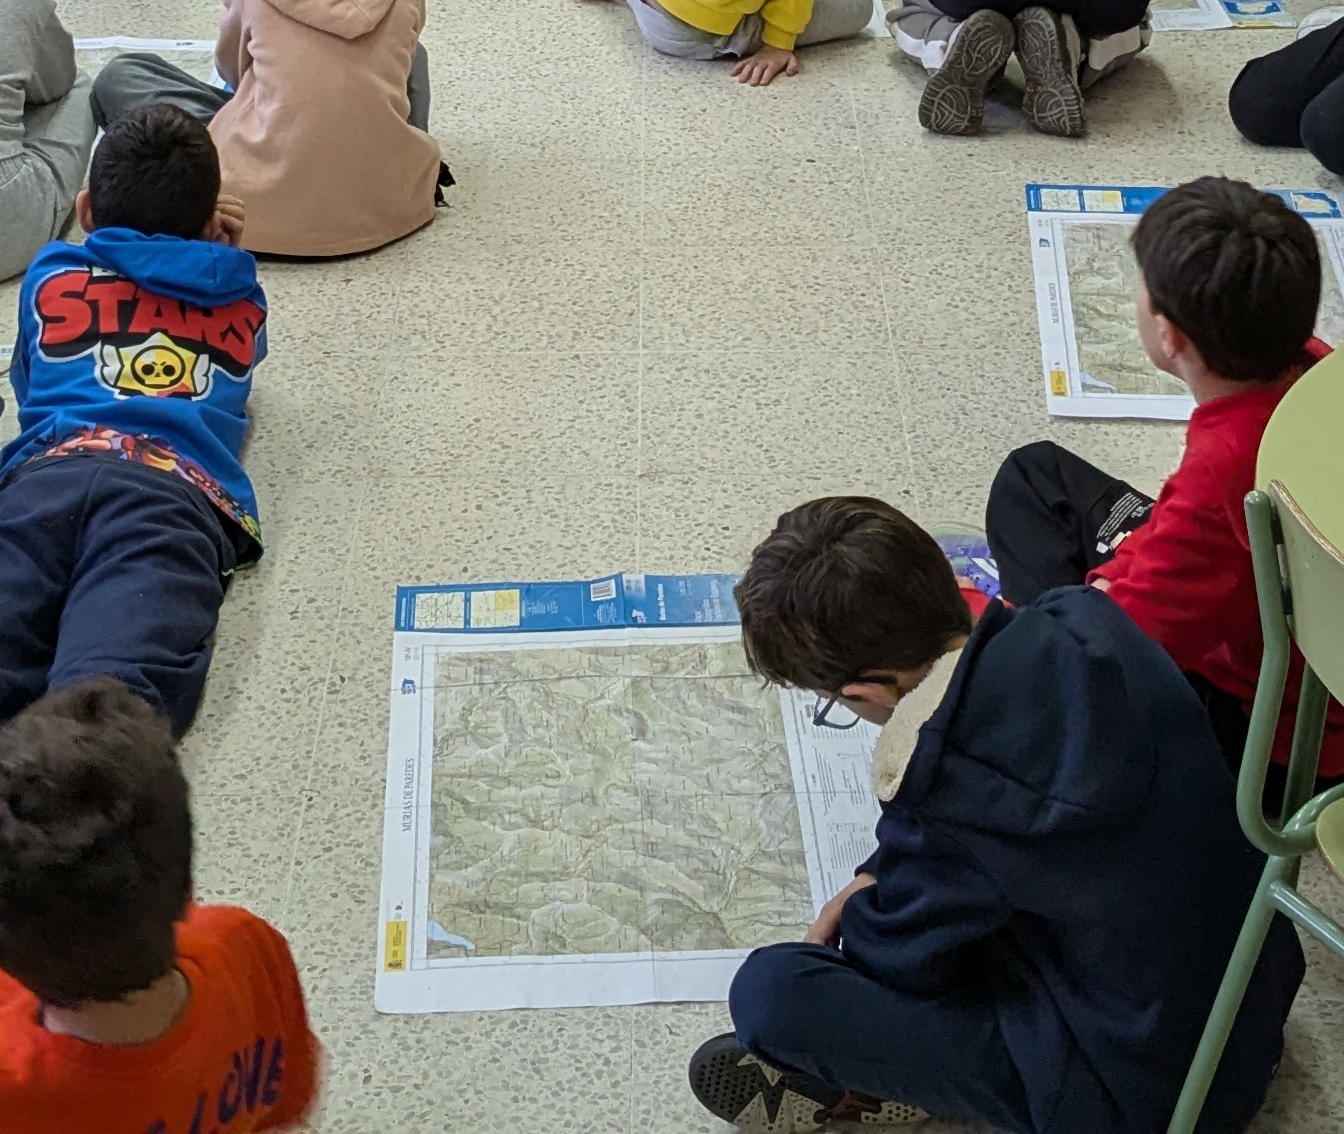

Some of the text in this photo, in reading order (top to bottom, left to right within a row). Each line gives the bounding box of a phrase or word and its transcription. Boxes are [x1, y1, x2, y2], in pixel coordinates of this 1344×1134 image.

[37, 269, 266, 366] STARS
[402, 758, 414, 832] MURIAS DE PAREDES
